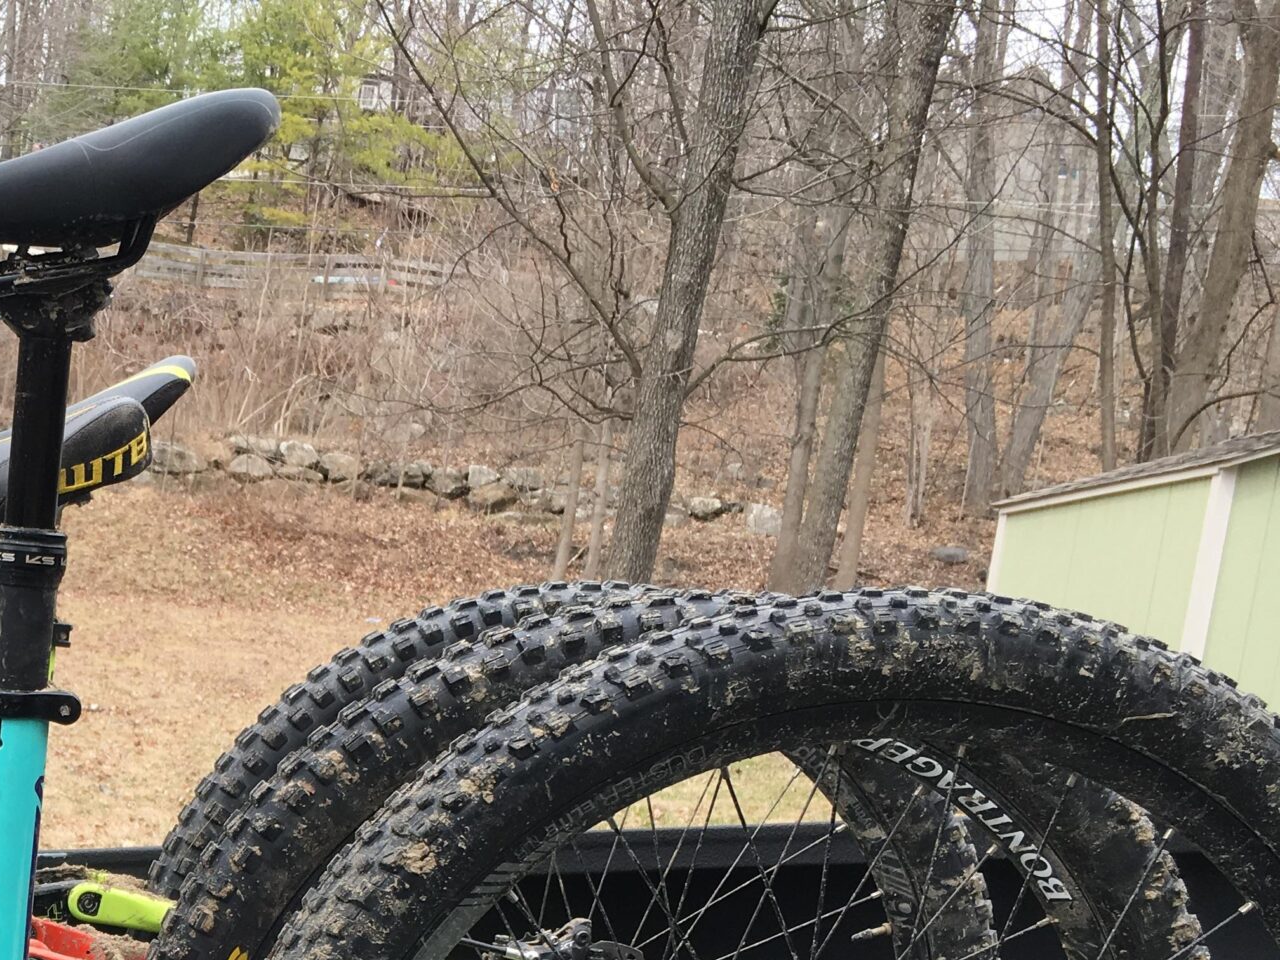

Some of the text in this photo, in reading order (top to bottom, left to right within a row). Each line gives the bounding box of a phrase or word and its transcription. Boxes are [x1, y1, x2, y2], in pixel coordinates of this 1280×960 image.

[25, 553, 56, 566] KS
[598, 745, 707, 807] DUSTER
[851, 737, 1073, 901] BONTRAGER
